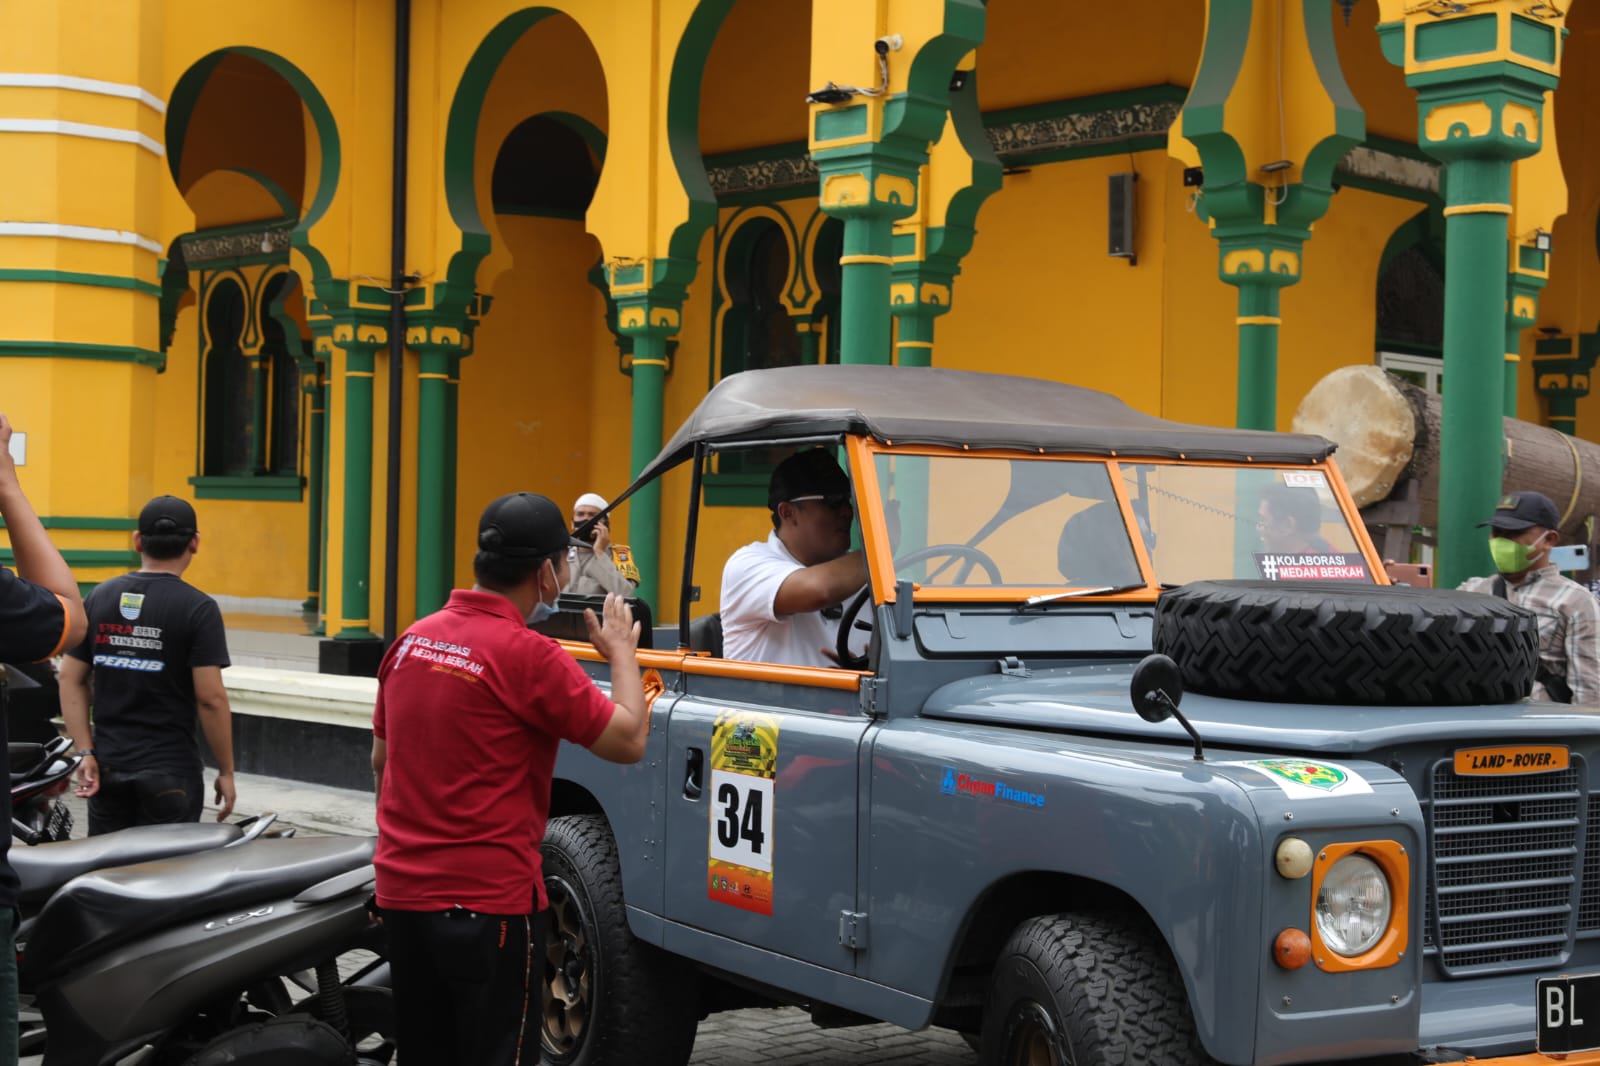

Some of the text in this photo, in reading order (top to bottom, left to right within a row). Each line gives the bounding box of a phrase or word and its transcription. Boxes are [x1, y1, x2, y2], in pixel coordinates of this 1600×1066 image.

[1276, 555, 1346, 566] KOLABORASI
[1279, 566, 1364, 578] MEDAN BERKAH
[415, 635, 472, 657] KOLABORASI
[93, 655, 165, 672] PERSIB
[410, 647, 445, 663] MEDAN
[444, 655, 485, 675] BERKAH
[1472, 752, 1552, 769] LAND-ROVER
[717, 782, 765, 855] 34
[1546, 984, 1584, 1028] BL
